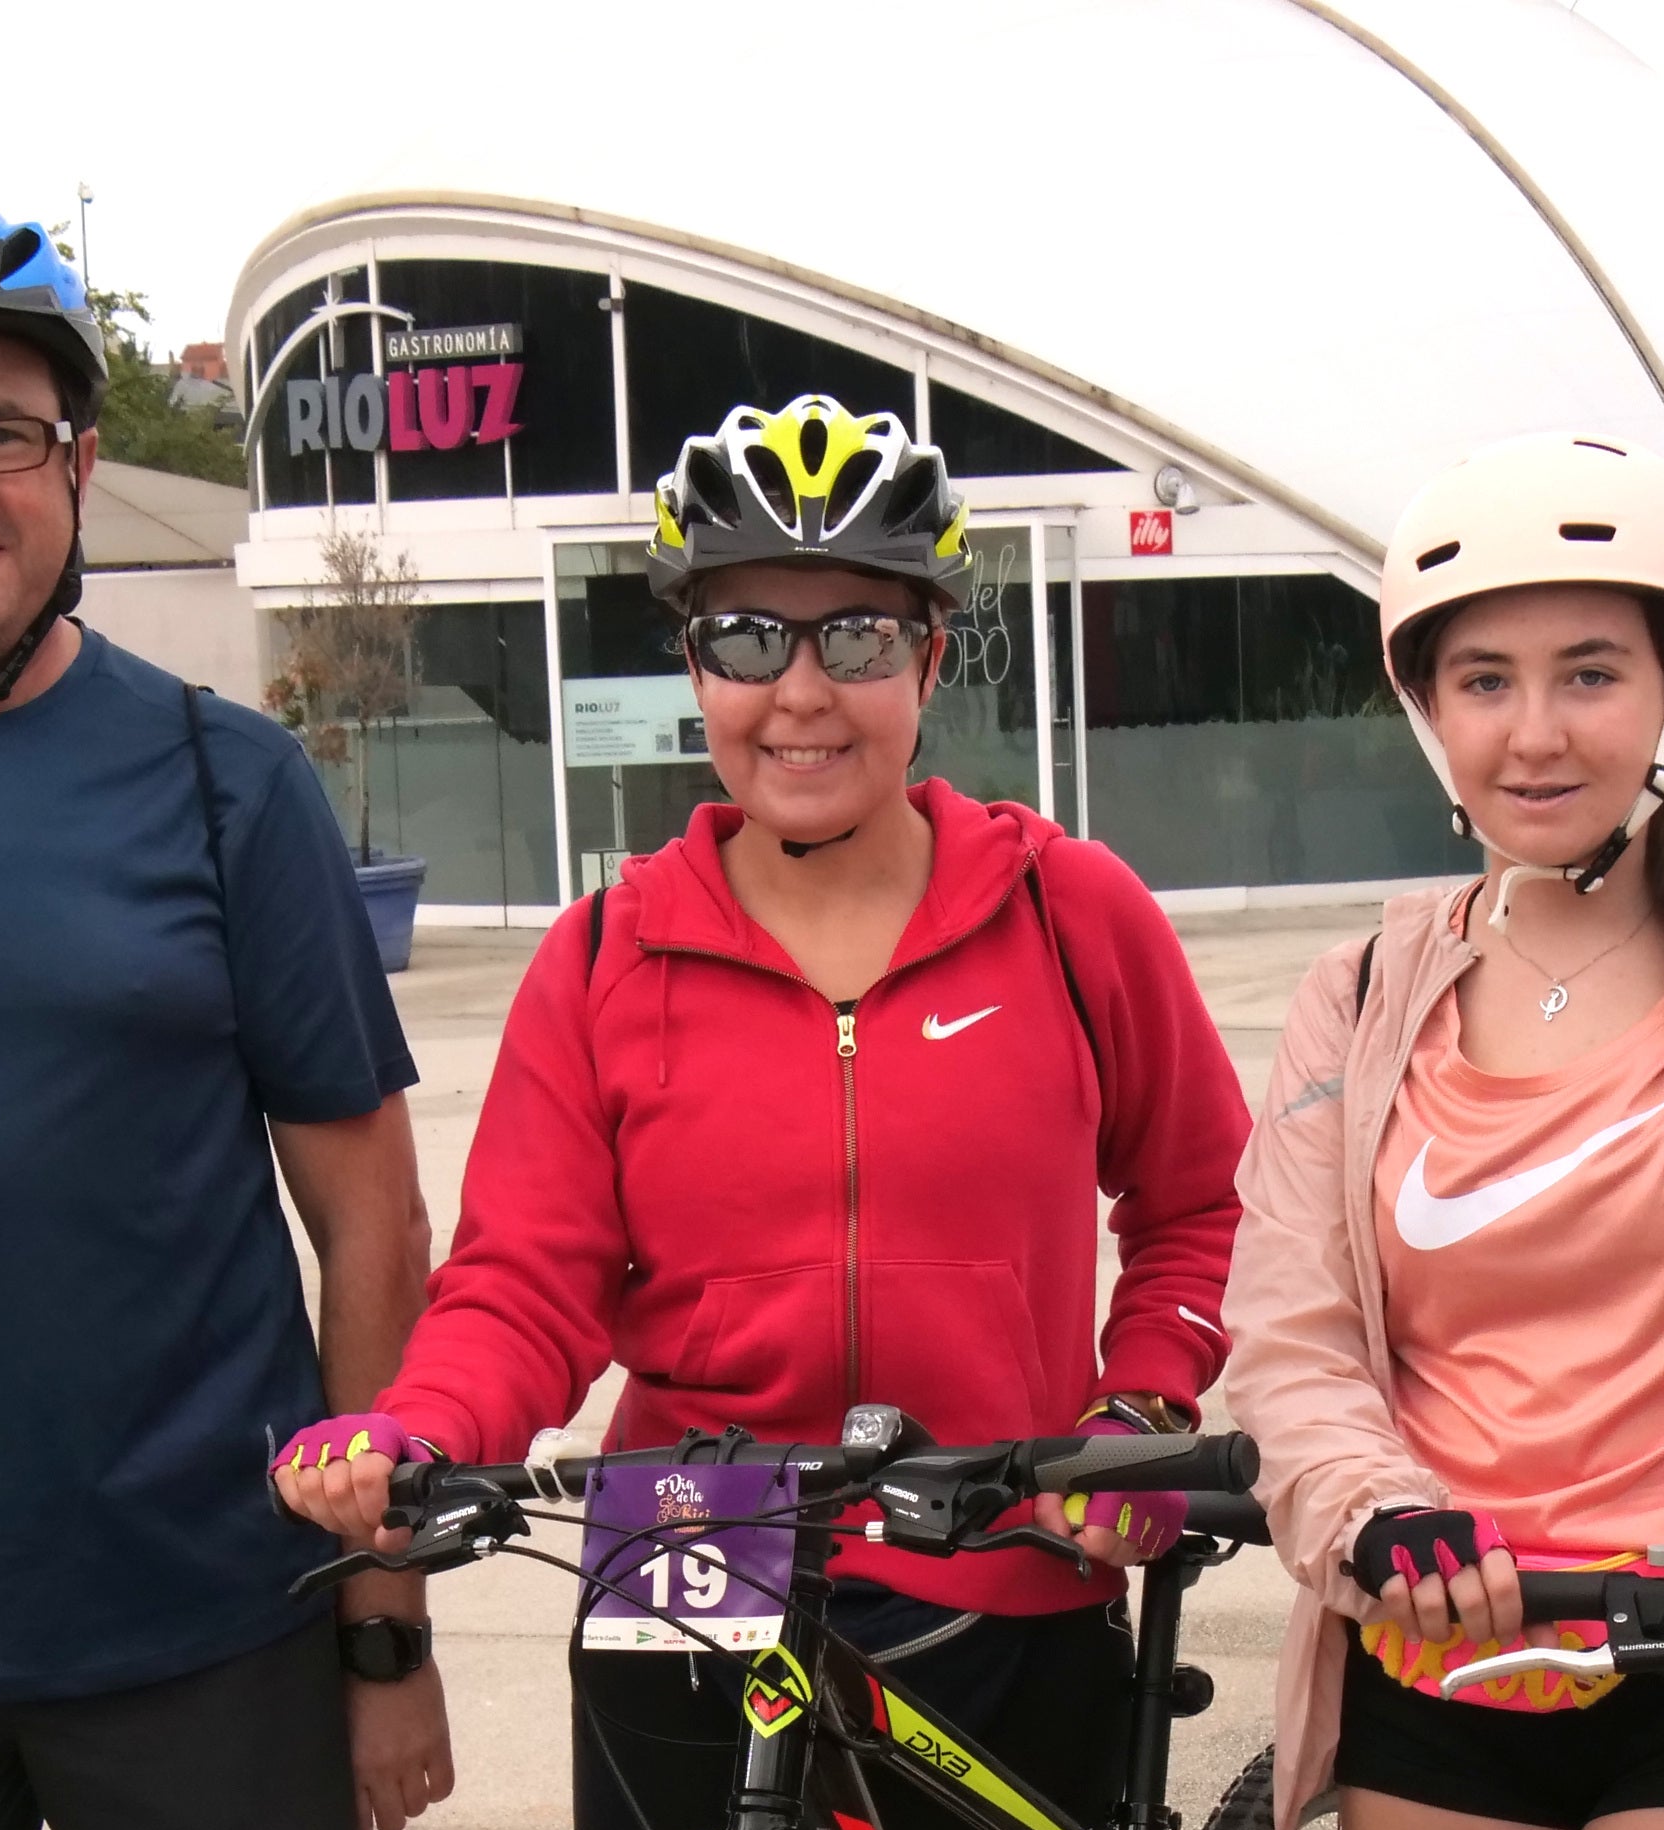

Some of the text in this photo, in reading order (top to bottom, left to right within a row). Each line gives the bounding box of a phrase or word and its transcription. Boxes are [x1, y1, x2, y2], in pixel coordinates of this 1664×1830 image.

[389, 326, 510, 358] GASTRONOMÍA
[1133, 517, 1170, 551] illy
[640, 1543, 728, 1609] 19
[904, 1730, 972, 1778] DX3
